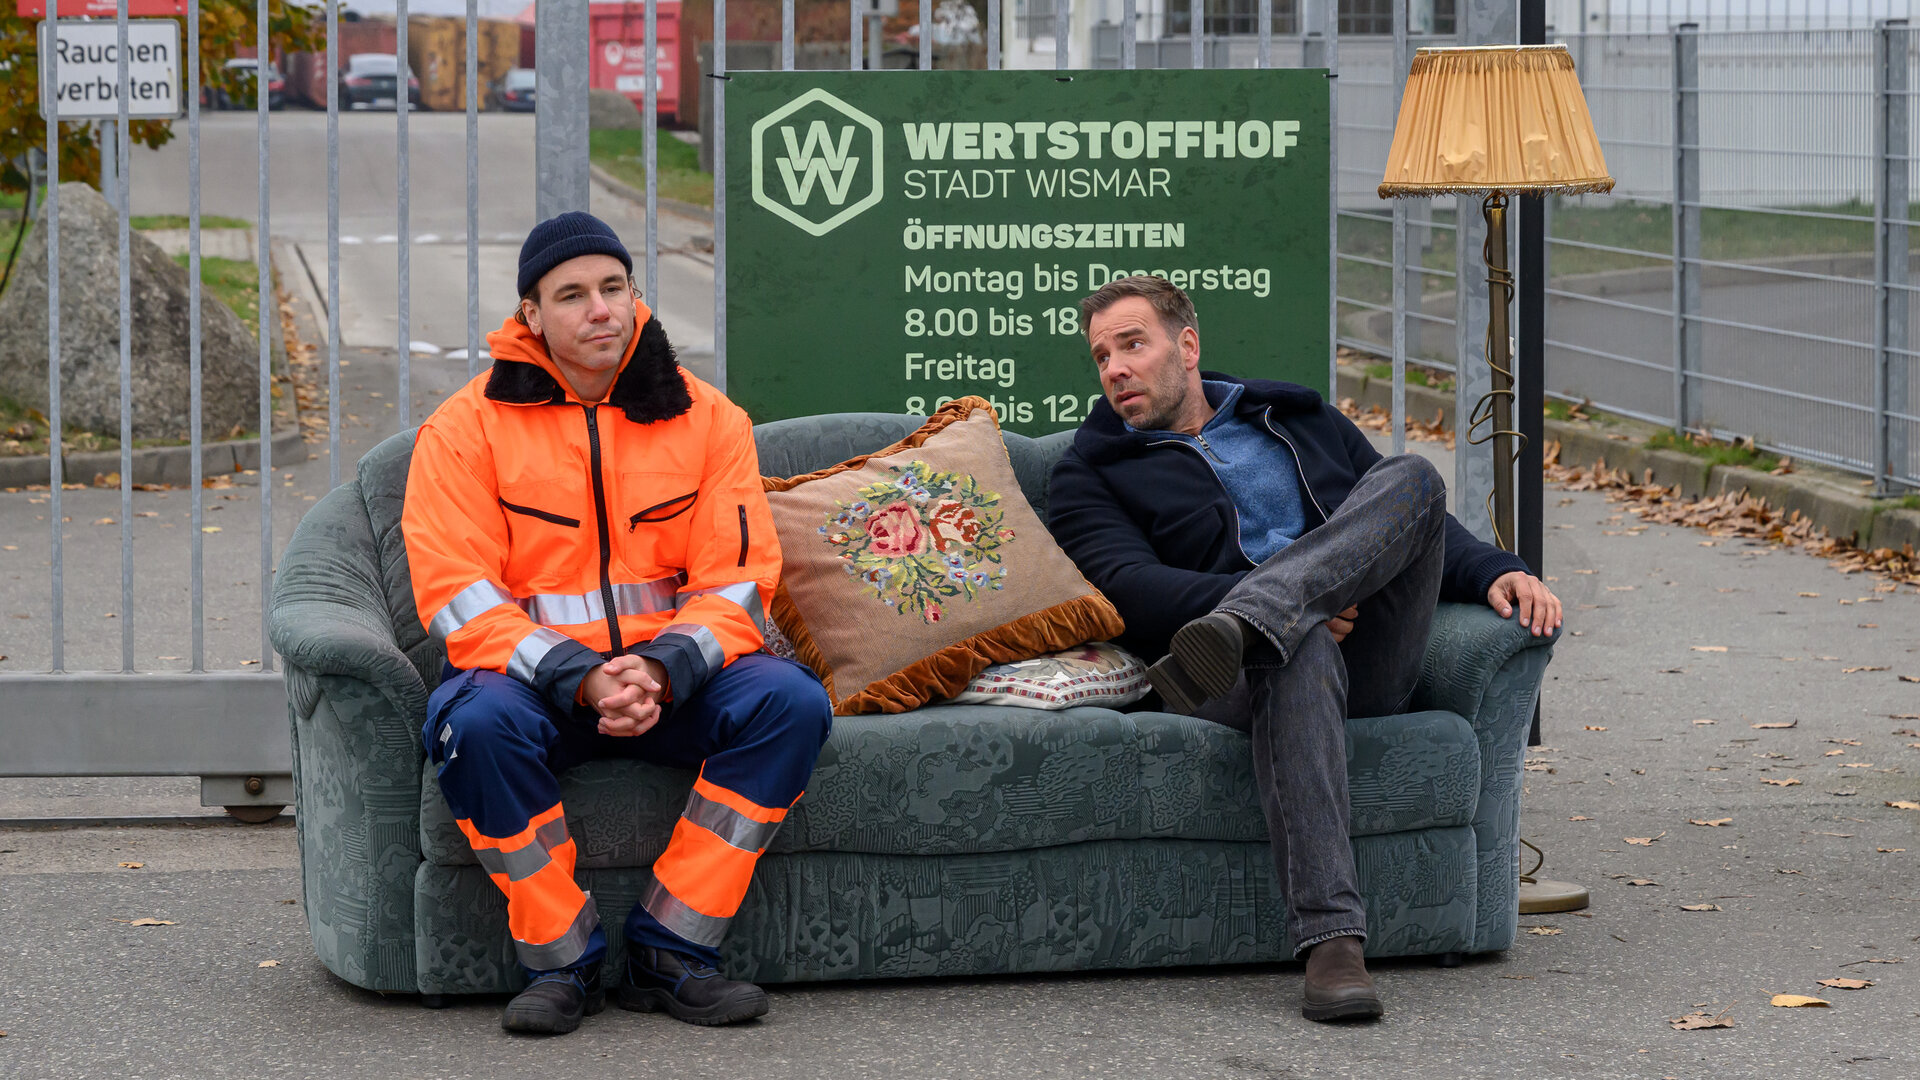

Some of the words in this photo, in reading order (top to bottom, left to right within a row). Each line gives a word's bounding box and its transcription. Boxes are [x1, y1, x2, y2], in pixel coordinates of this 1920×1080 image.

[903, 119, 1301, 162] WERTSTOFFHOF
[904, 168, 1016, 200] STADT
[1026, 167, 1171, 199] WISMAR
[903, 217, 1185, 251] ÖFFNUNGSZEITEN
[905, 265, 1024, 301] Montag
[1034, 262, 1079, 292] bis
[1088, 263, 1271, 299] Doerstag
[904, 308, 979, 338] 8.00
[989, 307, 1034, 337] bis
[905, 352, 1016, 388] Freitag
